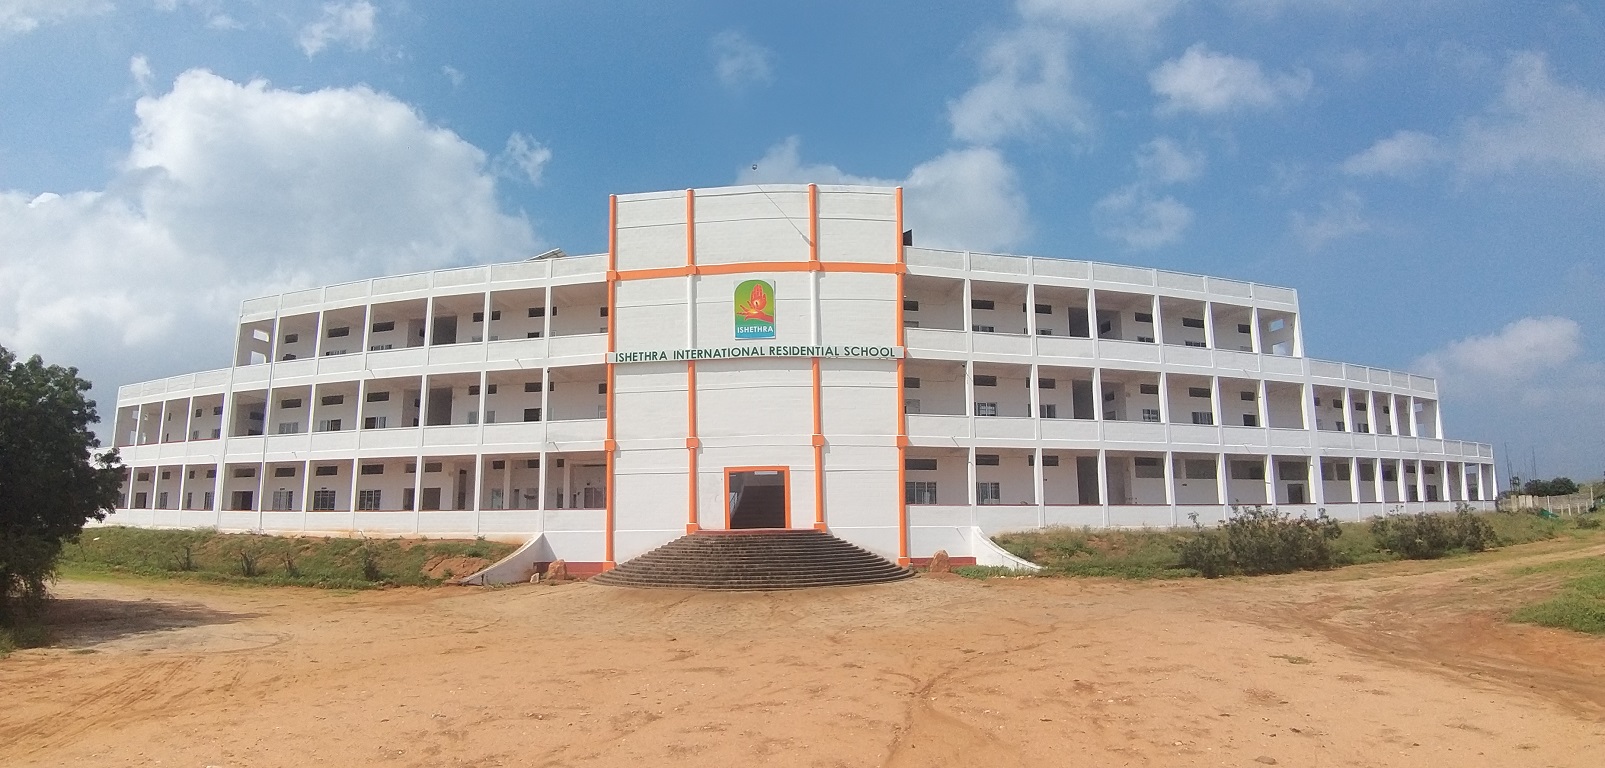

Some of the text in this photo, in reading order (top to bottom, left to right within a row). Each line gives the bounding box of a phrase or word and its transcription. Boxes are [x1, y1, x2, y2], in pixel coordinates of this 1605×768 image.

[615, 346, 895, 362] ISHETHRA INTERNATIONAL RESIDENTIAL SCHOOL
